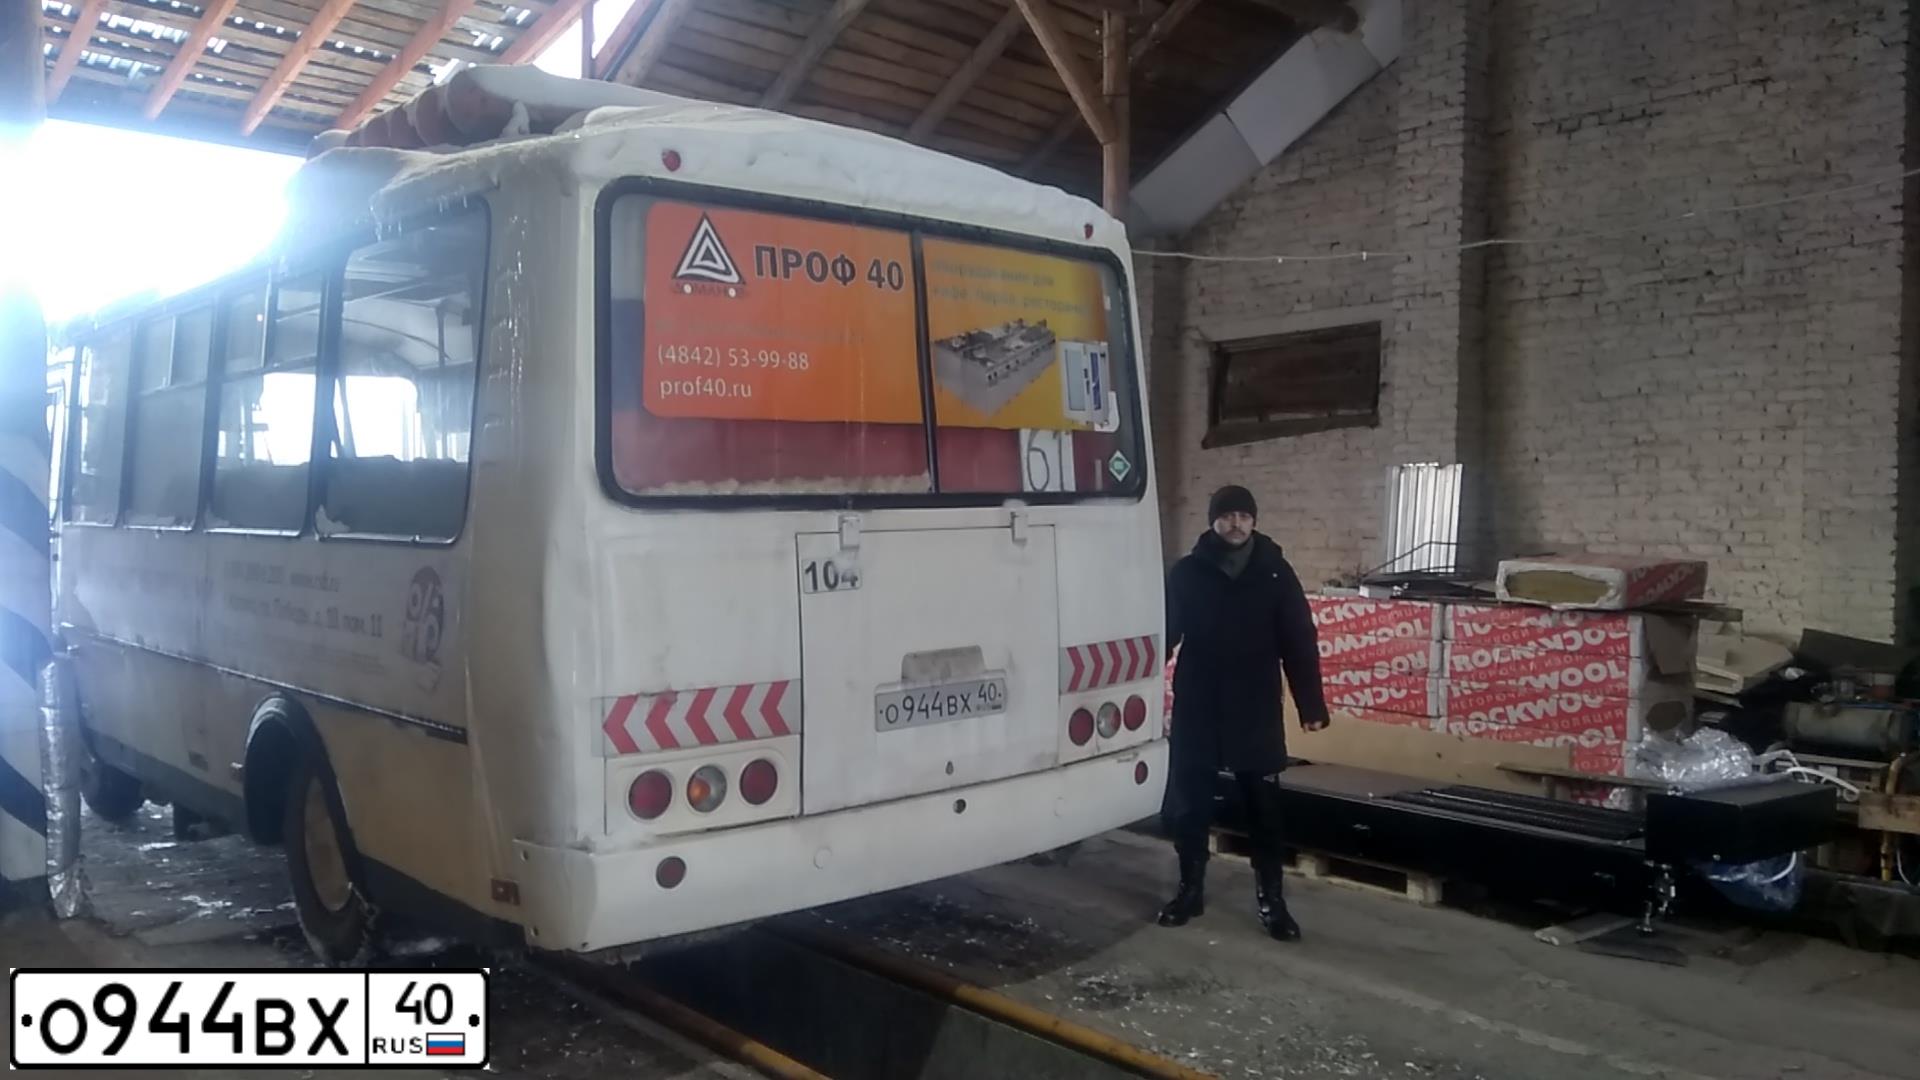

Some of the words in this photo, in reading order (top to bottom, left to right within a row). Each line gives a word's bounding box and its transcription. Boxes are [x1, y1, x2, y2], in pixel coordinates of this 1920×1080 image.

[755, 245, 857, 287] ПРОФ
[867, 258, 905, 292] 40
[657, 345, 721, 368] (4842)
[728, 348, 809, 371] 53-99-88
[660, 376, 752, 399] prof40.ru
[804, 560, 859, 592] 104
[978, 682, 998, 703] 40
